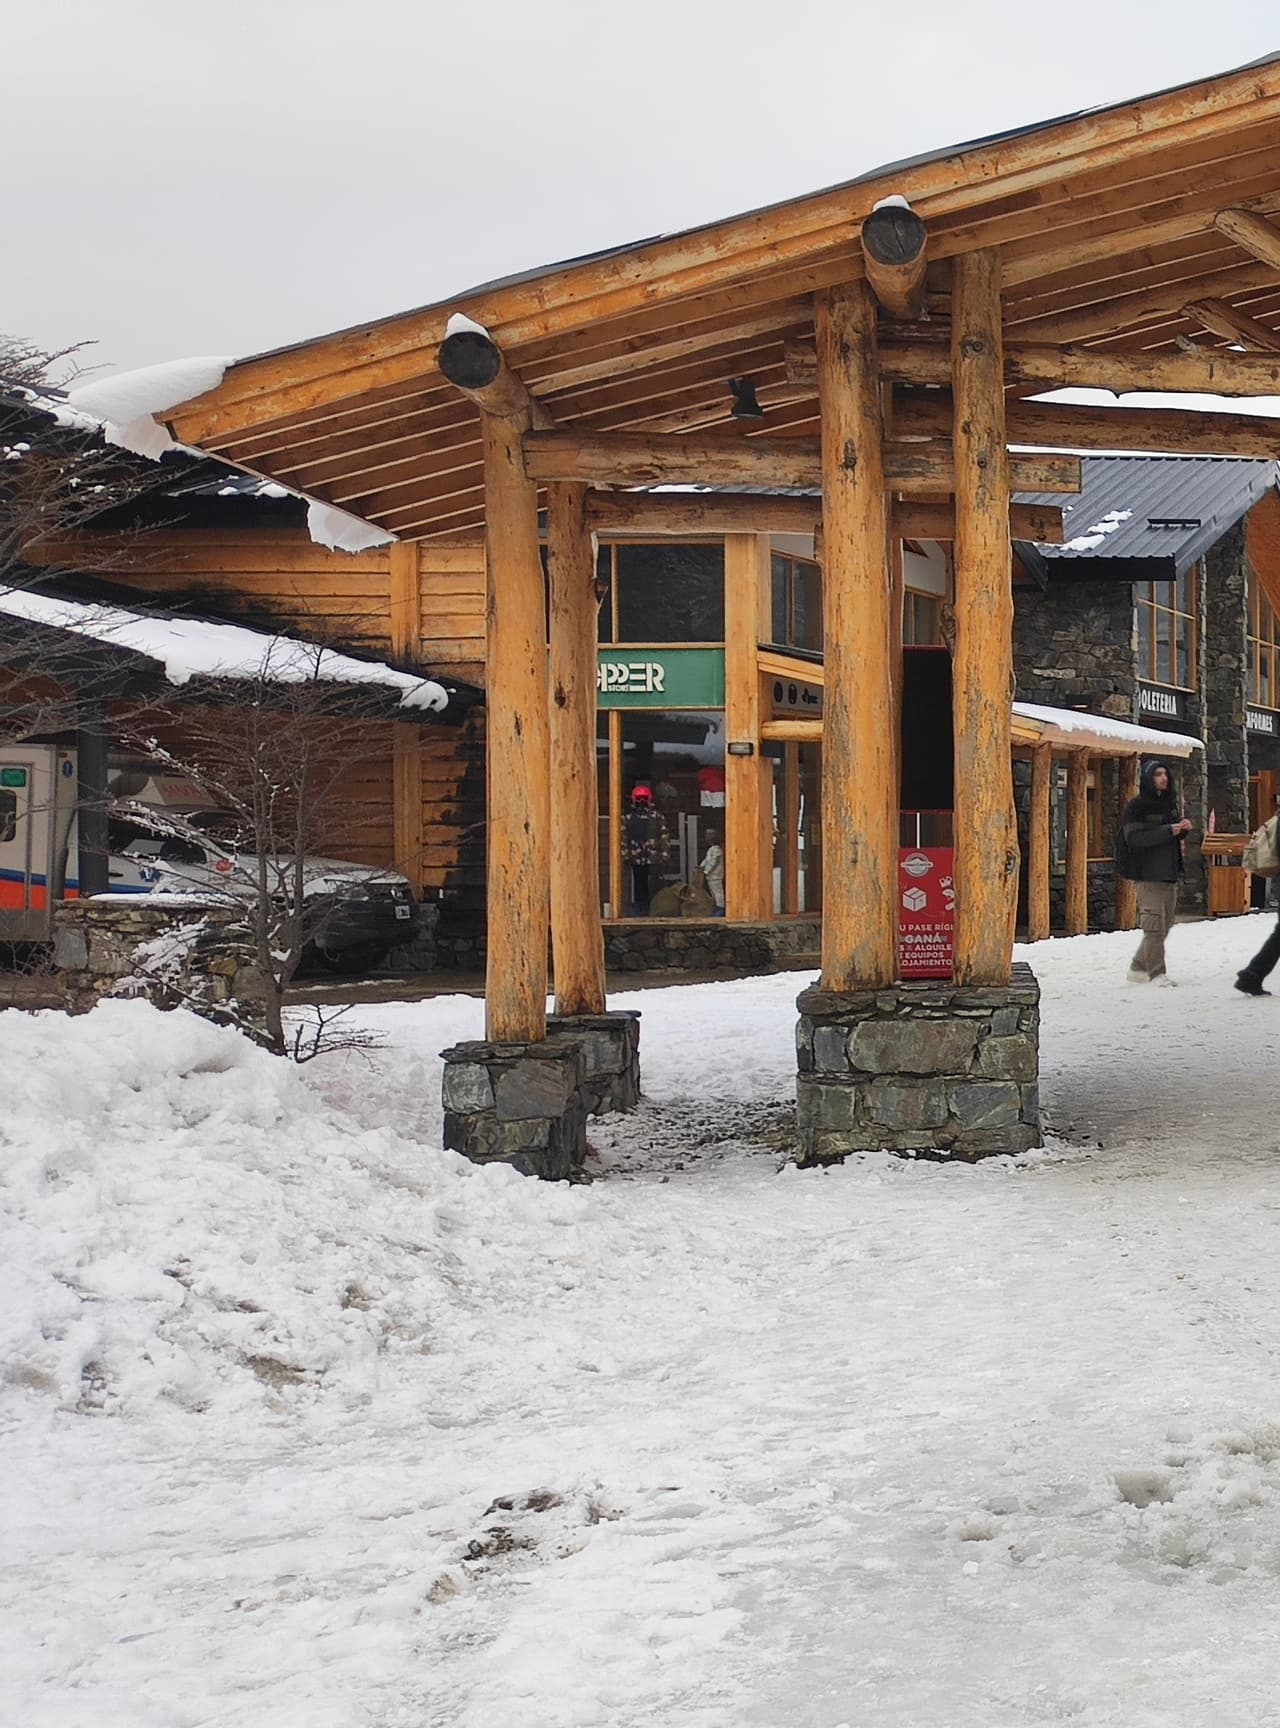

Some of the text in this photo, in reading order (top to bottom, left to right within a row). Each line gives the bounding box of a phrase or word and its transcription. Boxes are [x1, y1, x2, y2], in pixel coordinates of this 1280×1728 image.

[908, 924, 932, 932] PASE
[934, 922, 953, 932] RÍGI
[904, 932, 942, 944] GANÁ
[900, 959, 953, 967] OJAMIENTO
